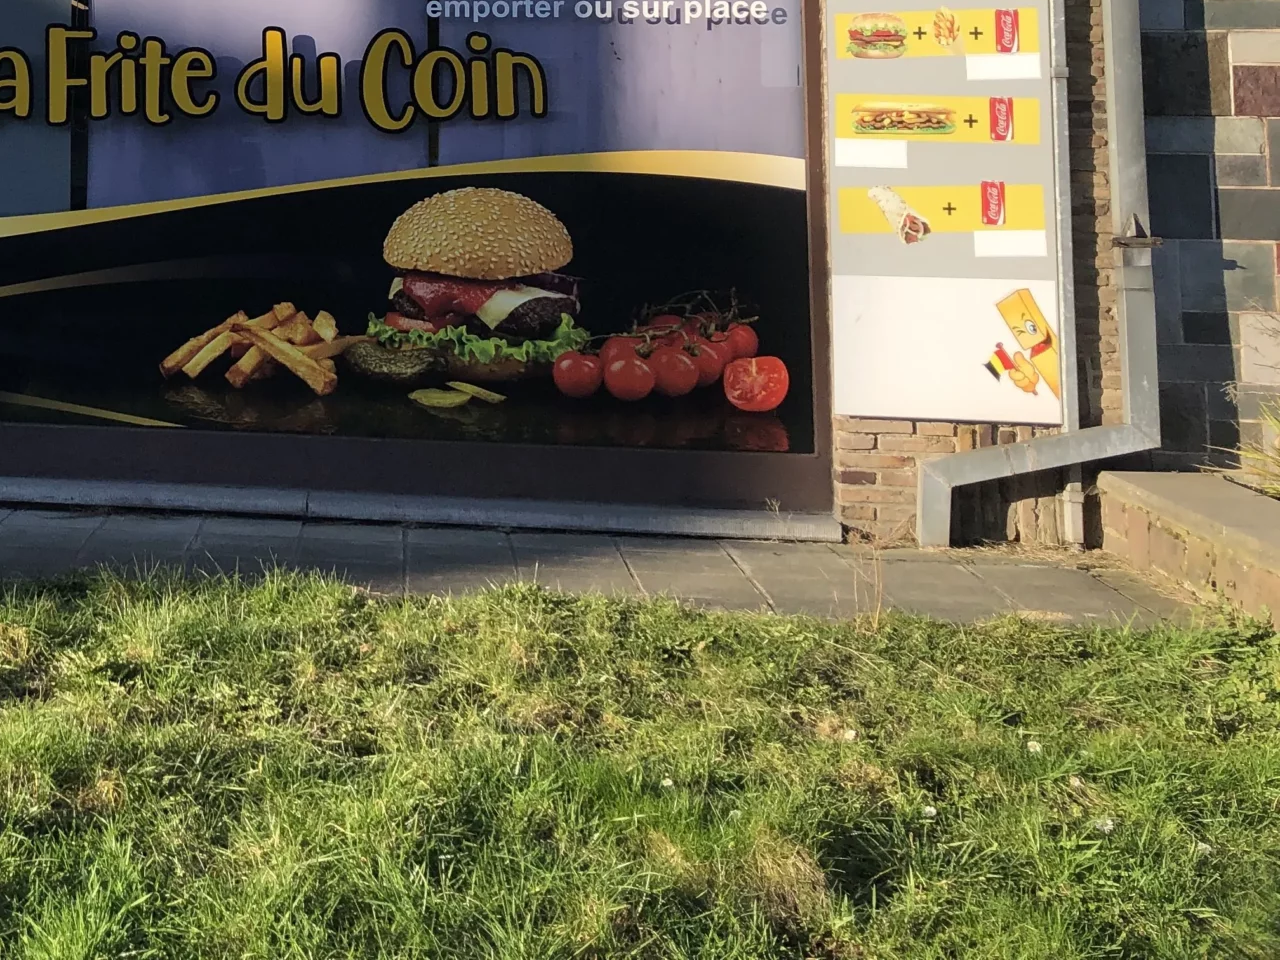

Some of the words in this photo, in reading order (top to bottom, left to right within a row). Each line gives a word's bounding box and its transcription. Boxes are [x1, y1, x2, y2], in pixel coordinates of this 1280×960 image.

[46, 25, 217, 125] Frite
[235, 27, 341, 121] du
[360, 29, 547, 133] Coin
